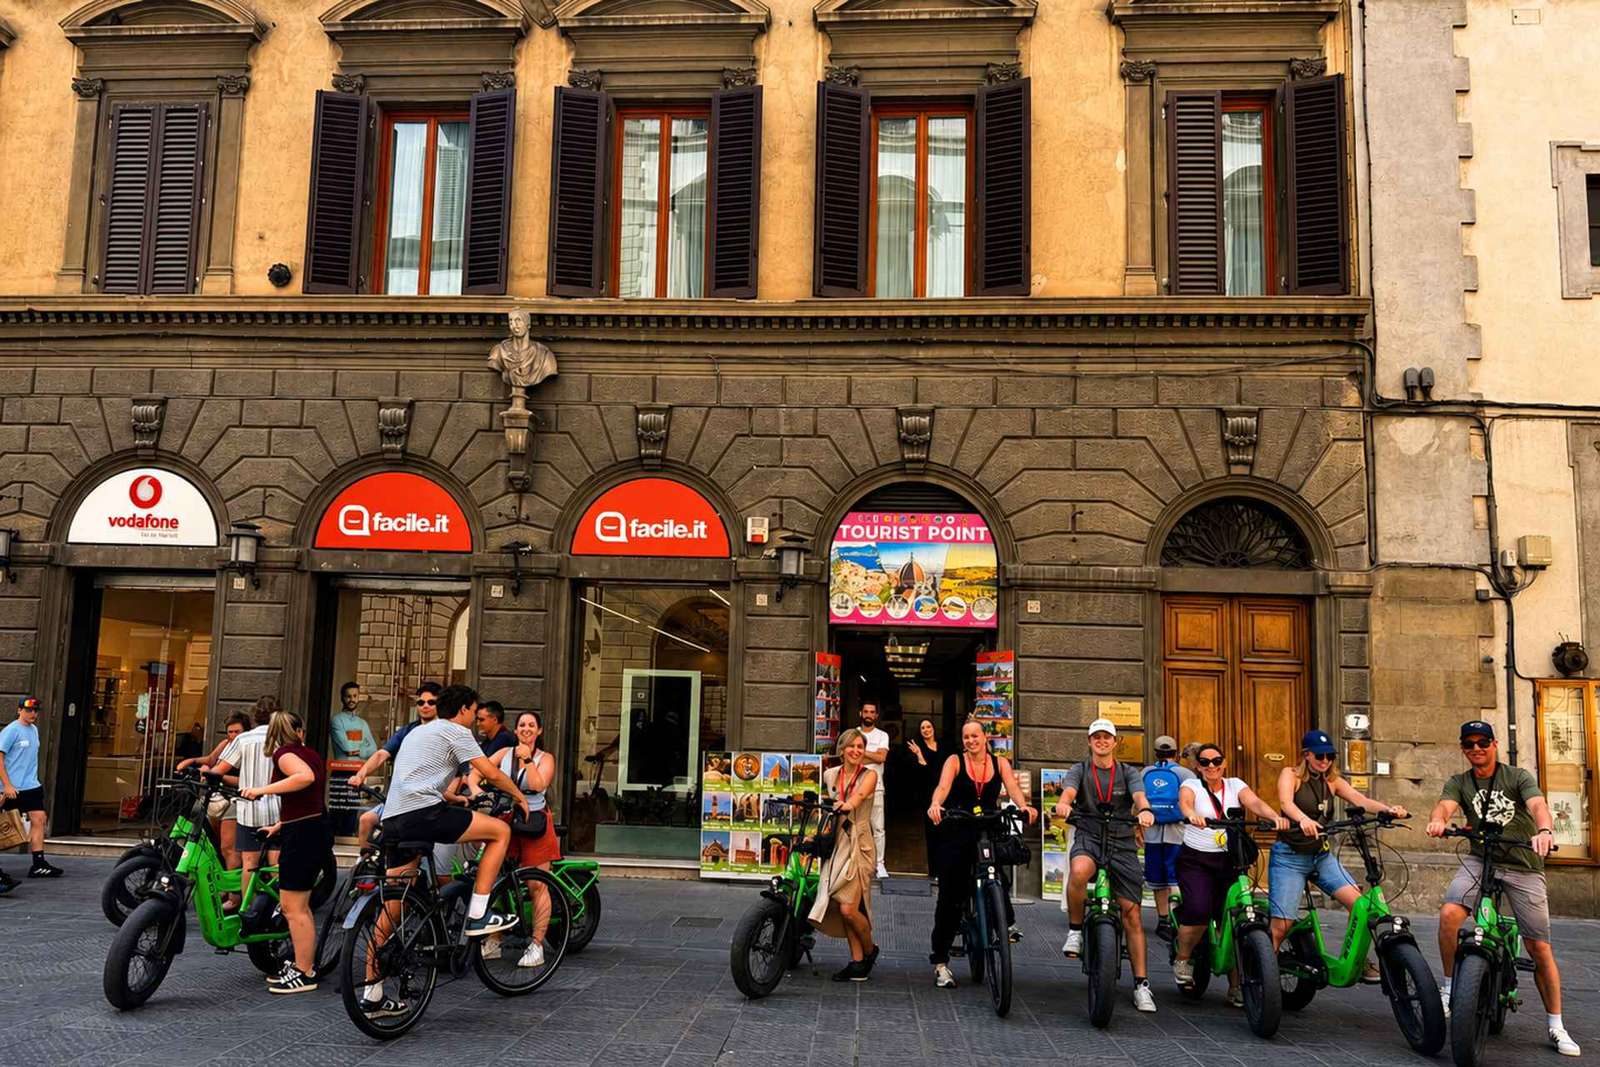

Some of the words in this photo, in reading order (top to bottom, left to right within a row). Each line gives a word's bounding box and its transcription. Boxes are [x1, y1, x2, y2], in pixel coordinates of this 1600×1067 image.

[108, 513, 179, 529] vodafone
[373, 512, 449, 533] facile.it
[629, 518, 708, 539] facile.it
[840, 524, 922, 540] TOURIST
[928, 525, 989, 541] POINT
[1353, 716, 1361, 727] 7
